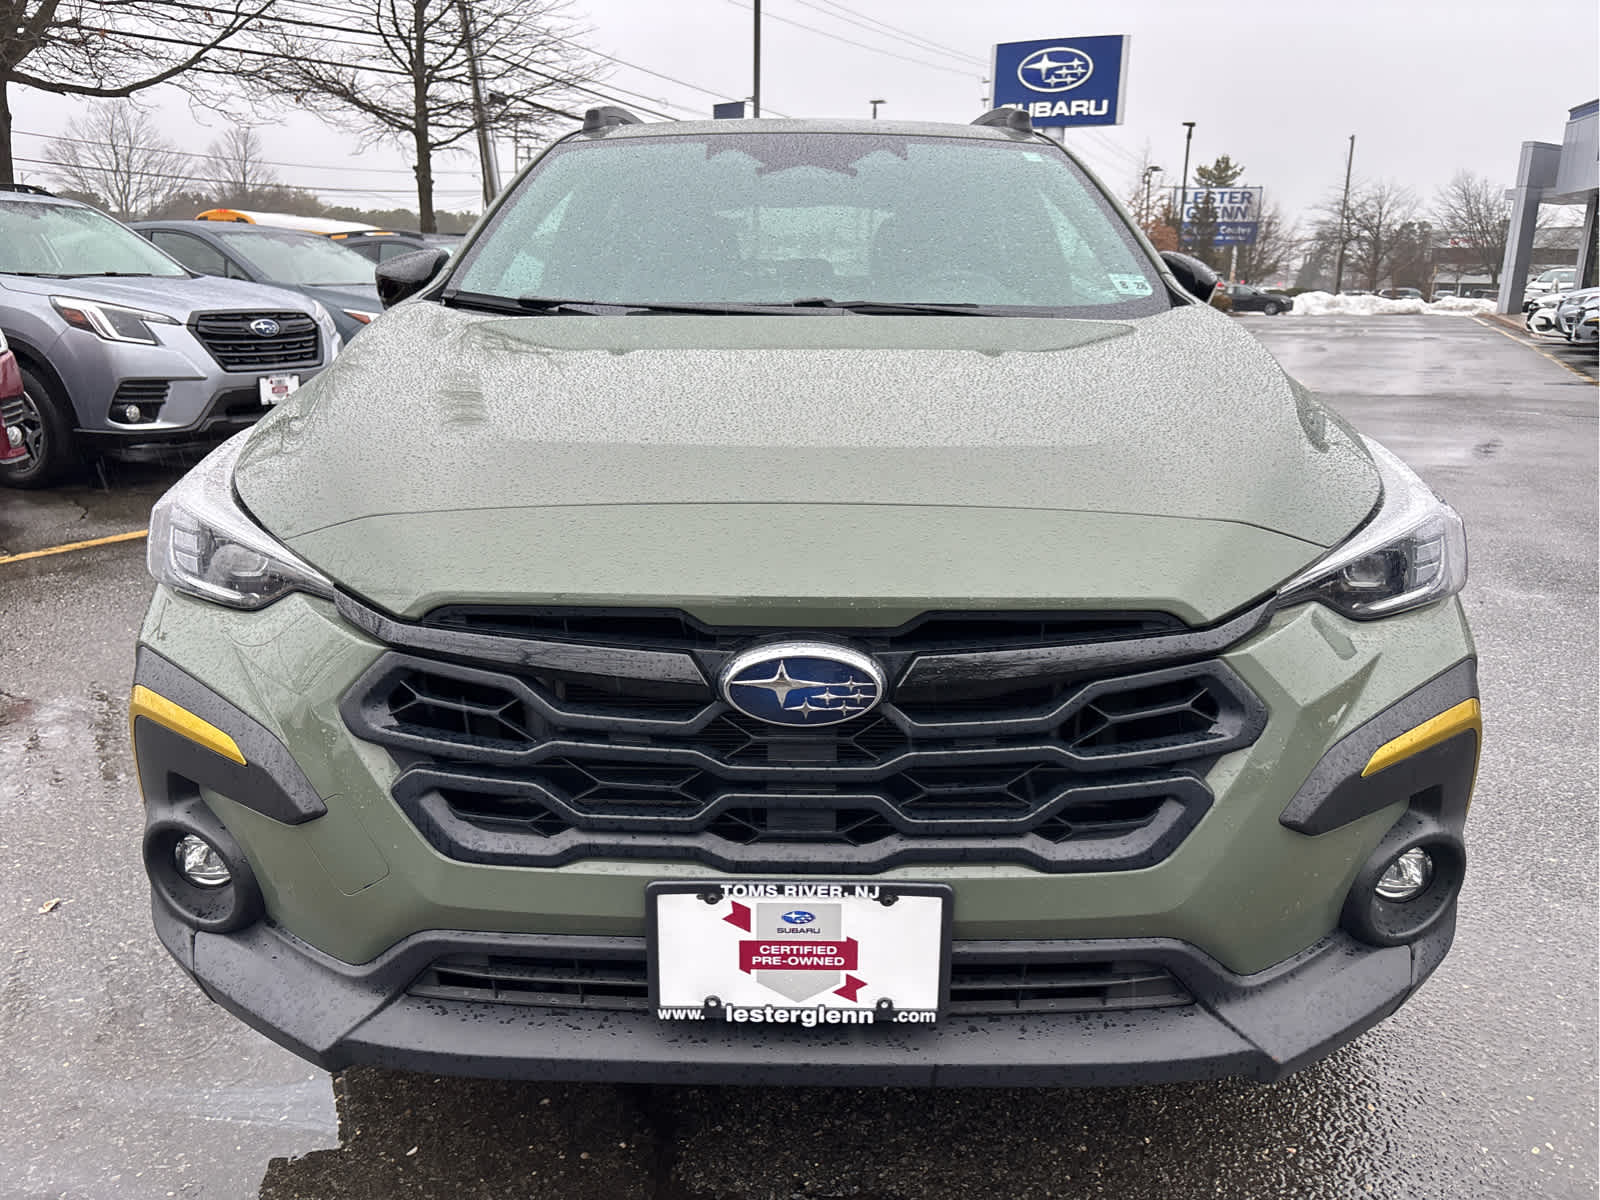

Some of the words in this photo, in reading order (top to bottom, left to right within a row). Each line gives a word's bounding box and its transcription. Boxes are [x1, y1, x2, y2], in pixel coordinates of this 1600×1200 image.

[1183, 191, 1252, 204] LESTER
[1186, 206, 1249, 219] GNN
[720, 884, 778, 897] TOMS
[854, 886, 880, 899] NJ
[759, 945, 838, 955] CERTIFIED
[751, 956, 846, 966] PRE-OWNED
[657, 1008, 706, 1020] www.
[726, 1005, 874, 1027] lesterglenn
[892, 1010, 937, 1023] .com
